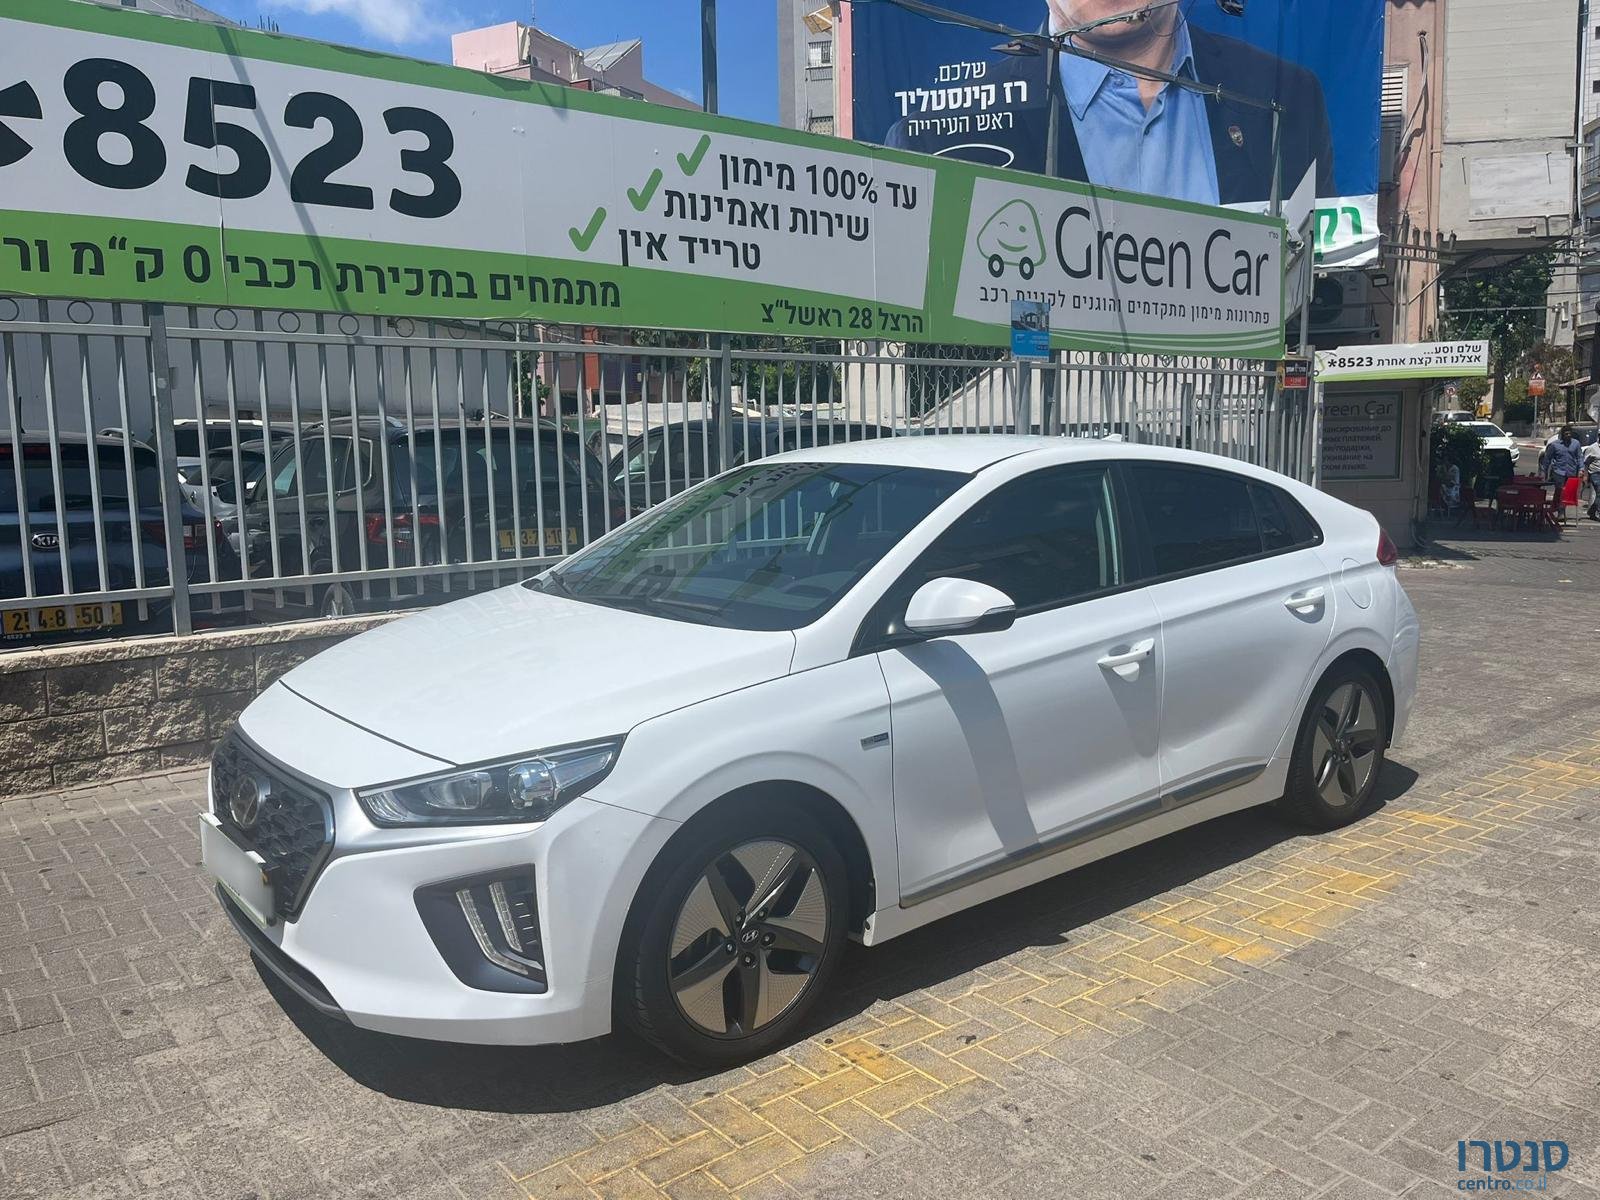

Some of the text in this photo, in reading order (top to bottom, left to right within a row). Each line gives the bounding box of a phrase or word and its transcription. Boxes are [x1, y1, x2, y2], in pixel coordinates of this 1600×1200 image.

[934, 61, 986, 84] שלכם,
[895, 79, 1028, 116] רז קינסטליך
[908, 111, 1014, 137] ראש העירייה
[719, 153, 917, 209] עד 100% מימון
[664, 189, 870, 241] שירות ואמינות
[618, 228, 761, 270] טרייד אין
[1055, 206, 1269, 297] Green Car
[184, 244, 212, 284] 0
[228, 254, 322, 291] רכבי
[336, 260, 475, 300] במכירת
[490, 273, 621, 308] מתמחים
[980, 286, 1009, 303] רכב
[1072, 296, 1122, 313] והוגנים
[848, 306, 873, 329] 28
[878, 308, 924, 333] הרצל
[1127, 302, 1186, 320] מתקדמים
[1191, 305, 1222, 322] מימון
[1226, 308, 1270, 324] פתרונות
[1435, 355, 1447, 364] זה
[1451, 354, 1481, 364] אצלנו
[1457, 344, 1482, 353] שלם
[1376, 357, 1406, 367] אחרת
[1409, 356, 1432, 367] קצת
[1322, 400, 1393, 417] reen Car
